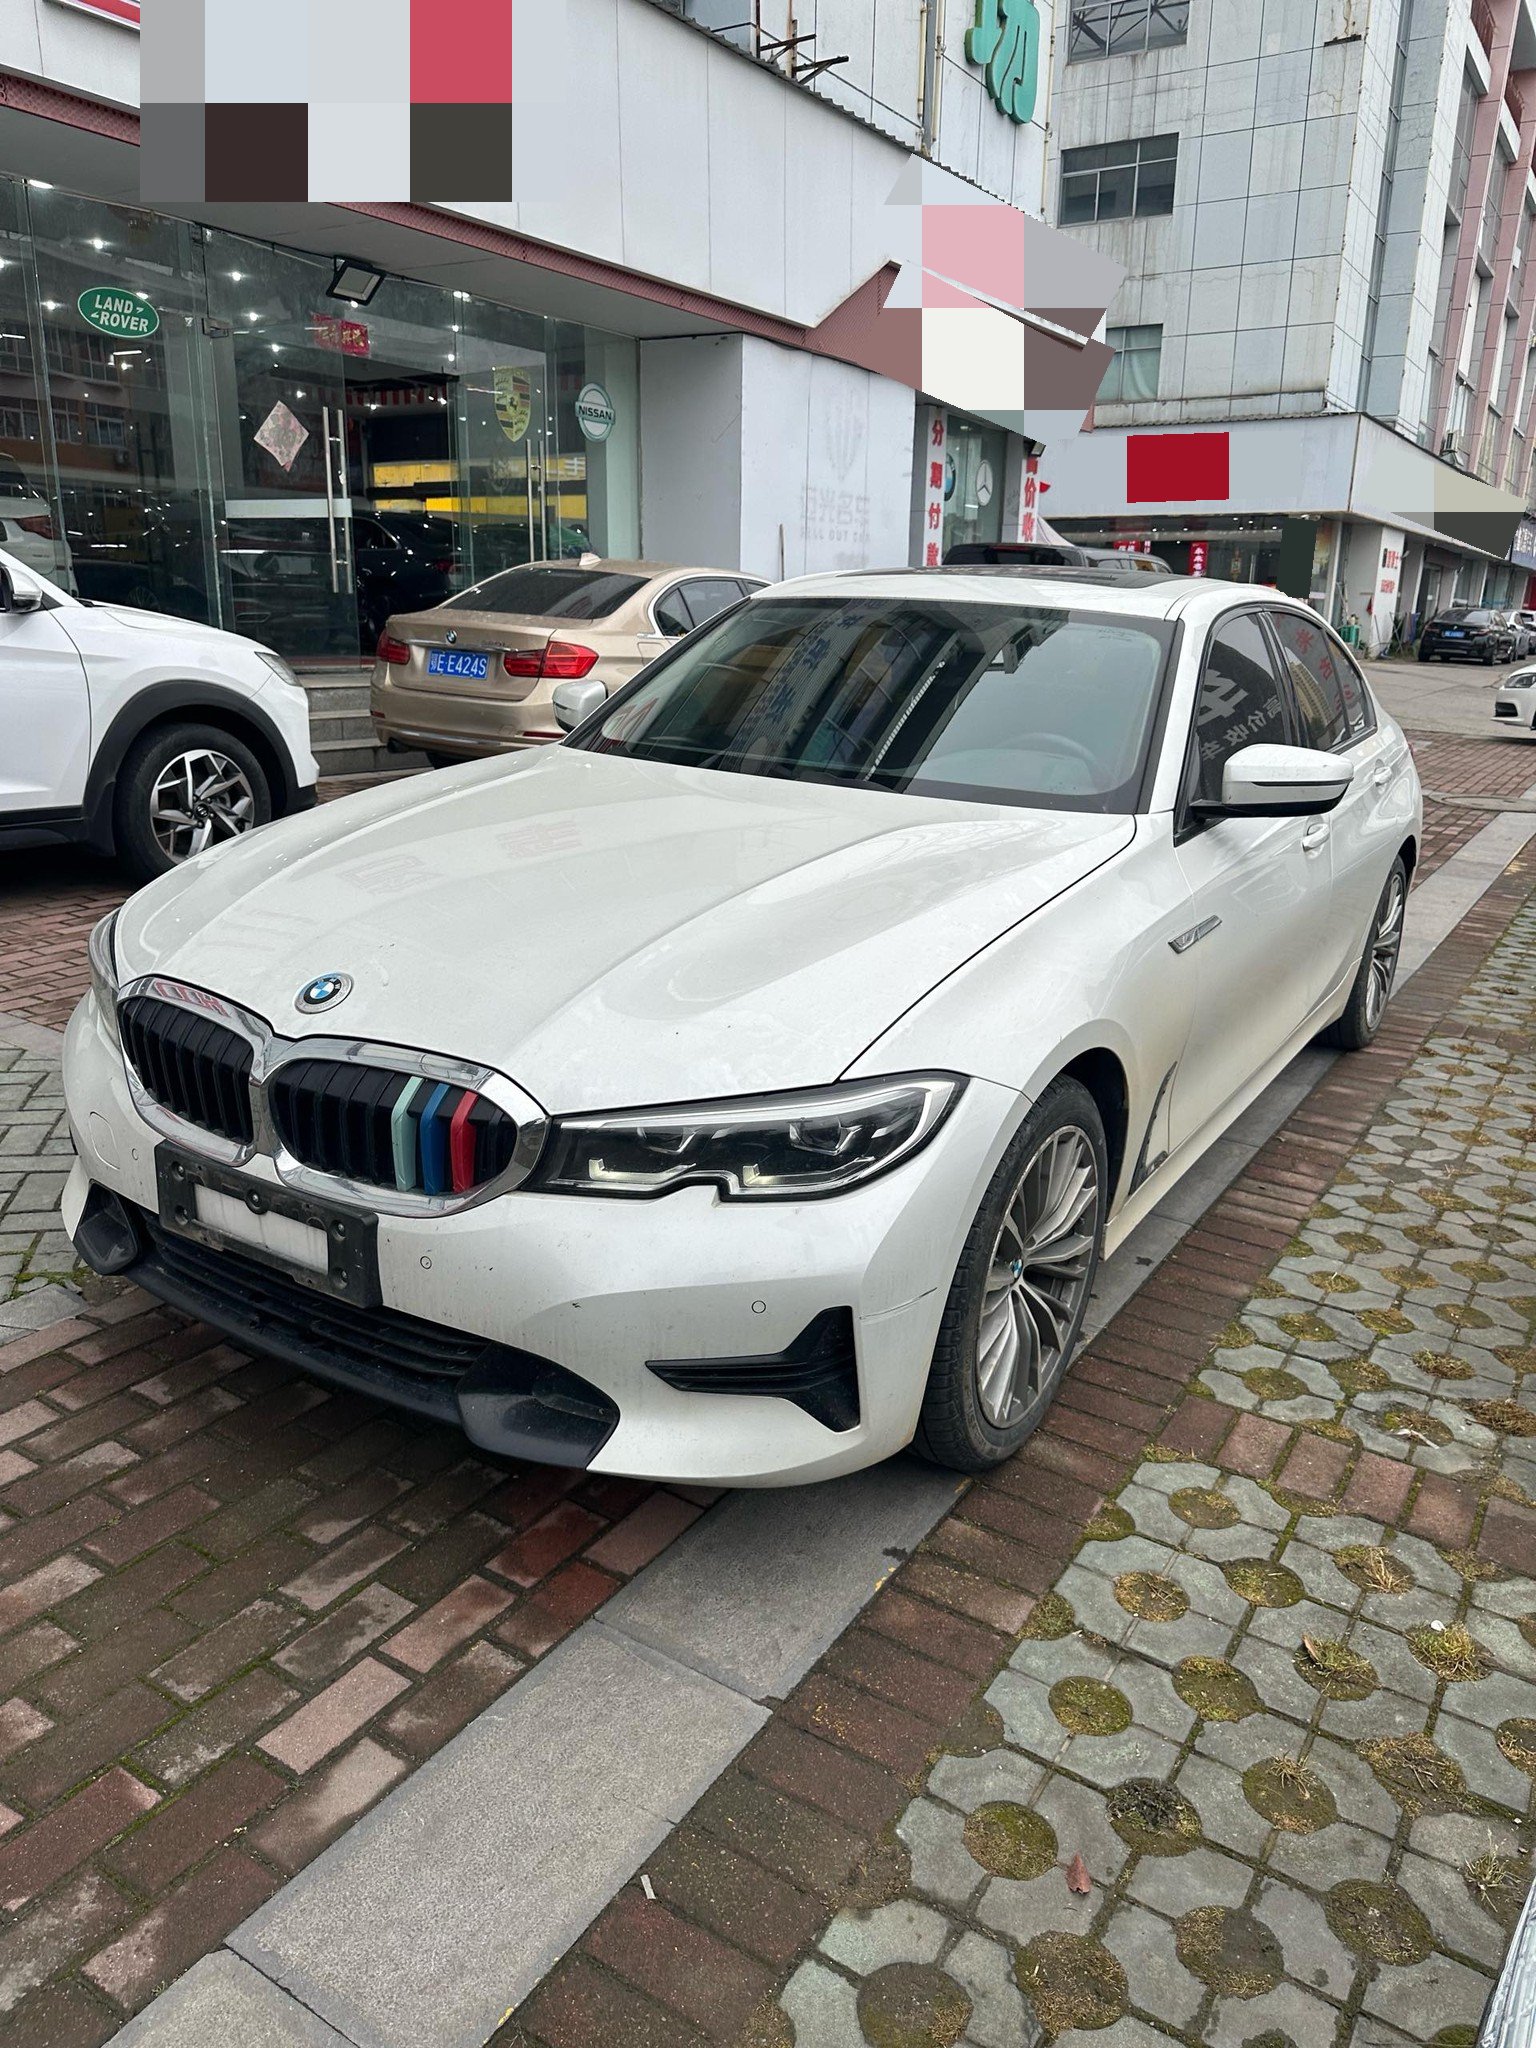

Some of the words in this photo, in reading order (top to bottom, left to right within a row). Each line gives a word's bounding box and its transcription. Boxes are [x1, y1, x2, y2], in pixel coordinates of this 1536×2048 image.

[94, 294, 134, 315] LAND
[99, 311, 149, 332] ROVER
[578, 404, 613, 421] NISSAN
